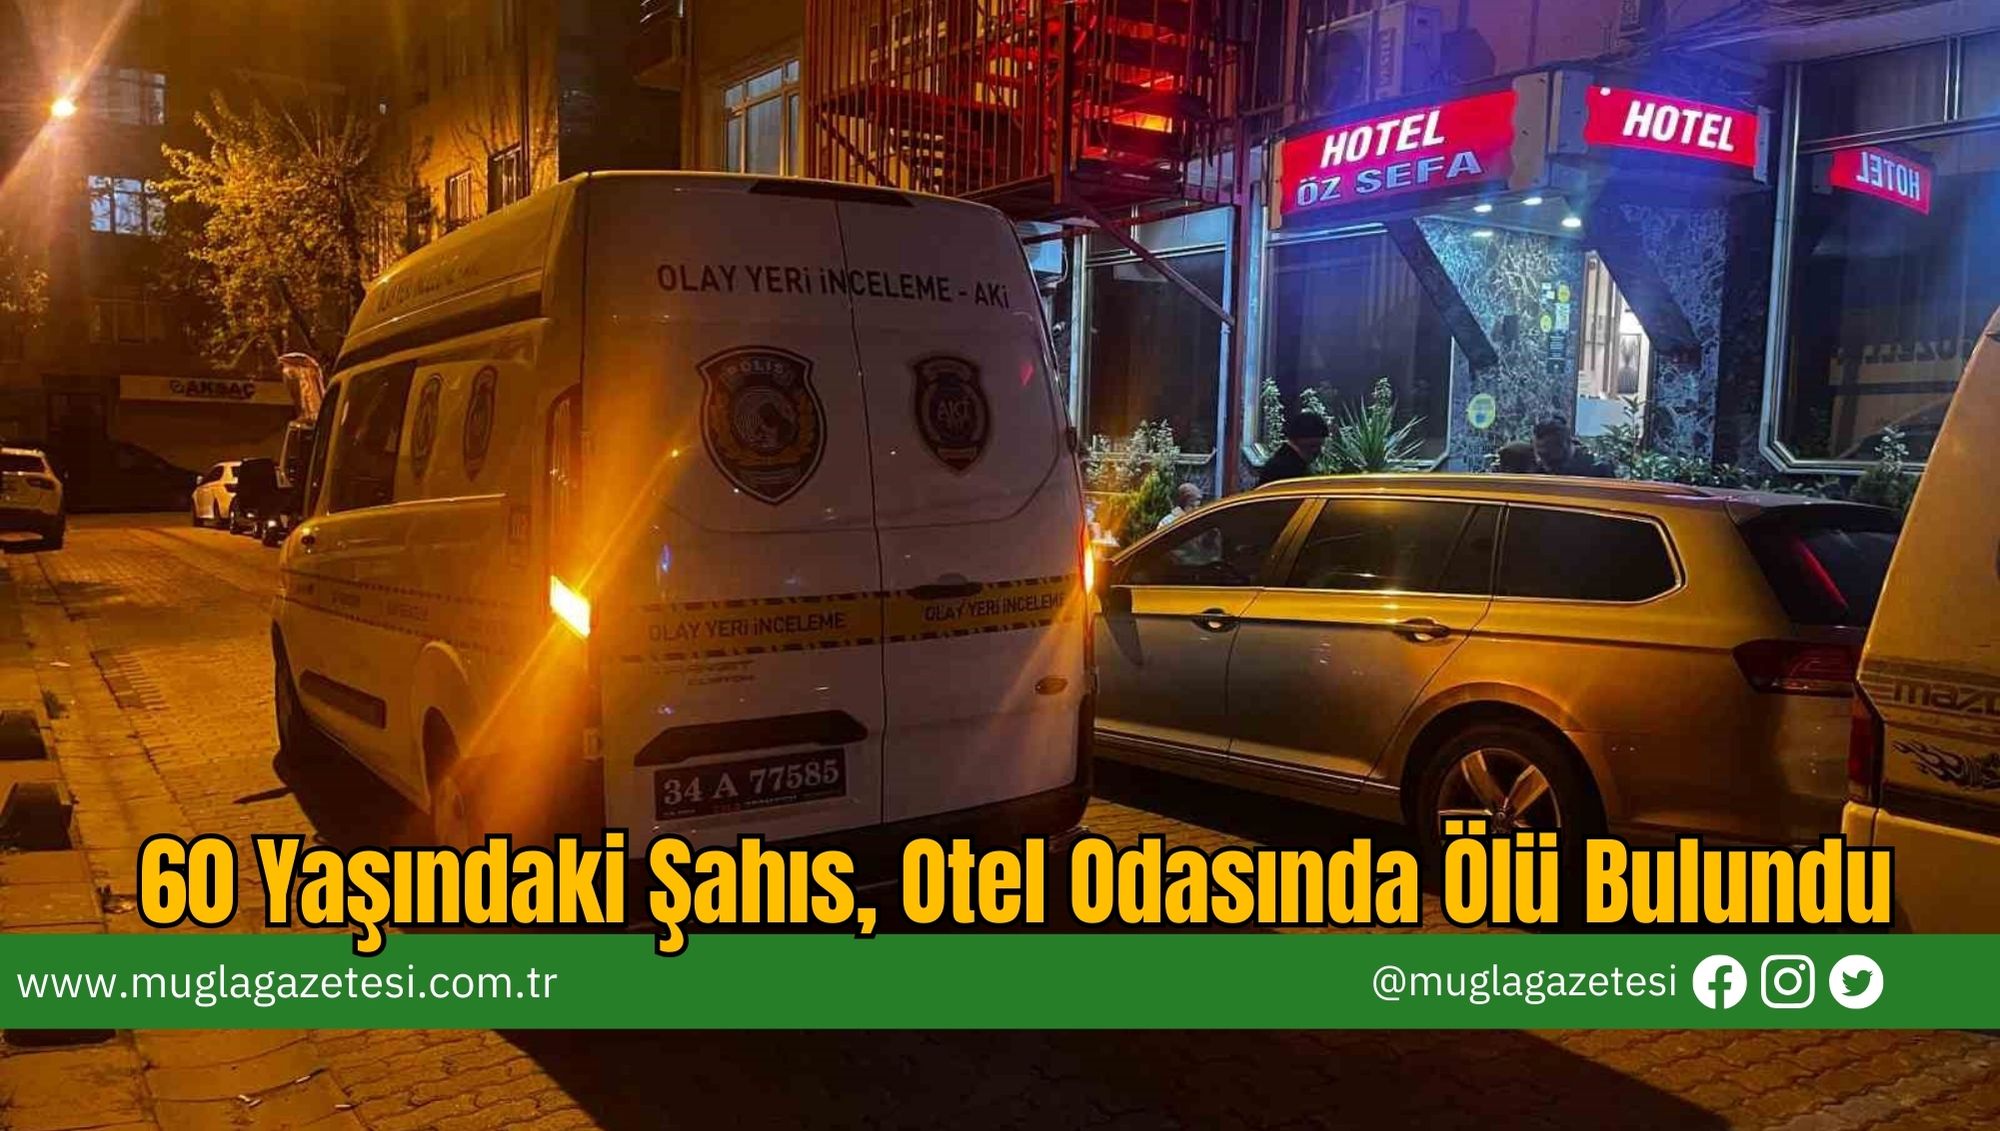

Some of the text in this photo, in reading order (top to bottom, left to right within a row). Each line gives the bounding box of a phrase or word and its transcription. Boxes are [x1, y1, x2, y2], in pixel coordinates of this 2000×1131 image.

[1320, 110, 1445, 168] HOTEL
[1623, 100, 1734, 152] HOTEL
[1297, 151, 1483, 206] ÖZ SEFA
[657, 264, 736, 292] OLAY
[648, 623, 700, 641] OLAY
[925, 604, 962, 621] OLAY
[664, 759, 839, 805] 34 A 77585
